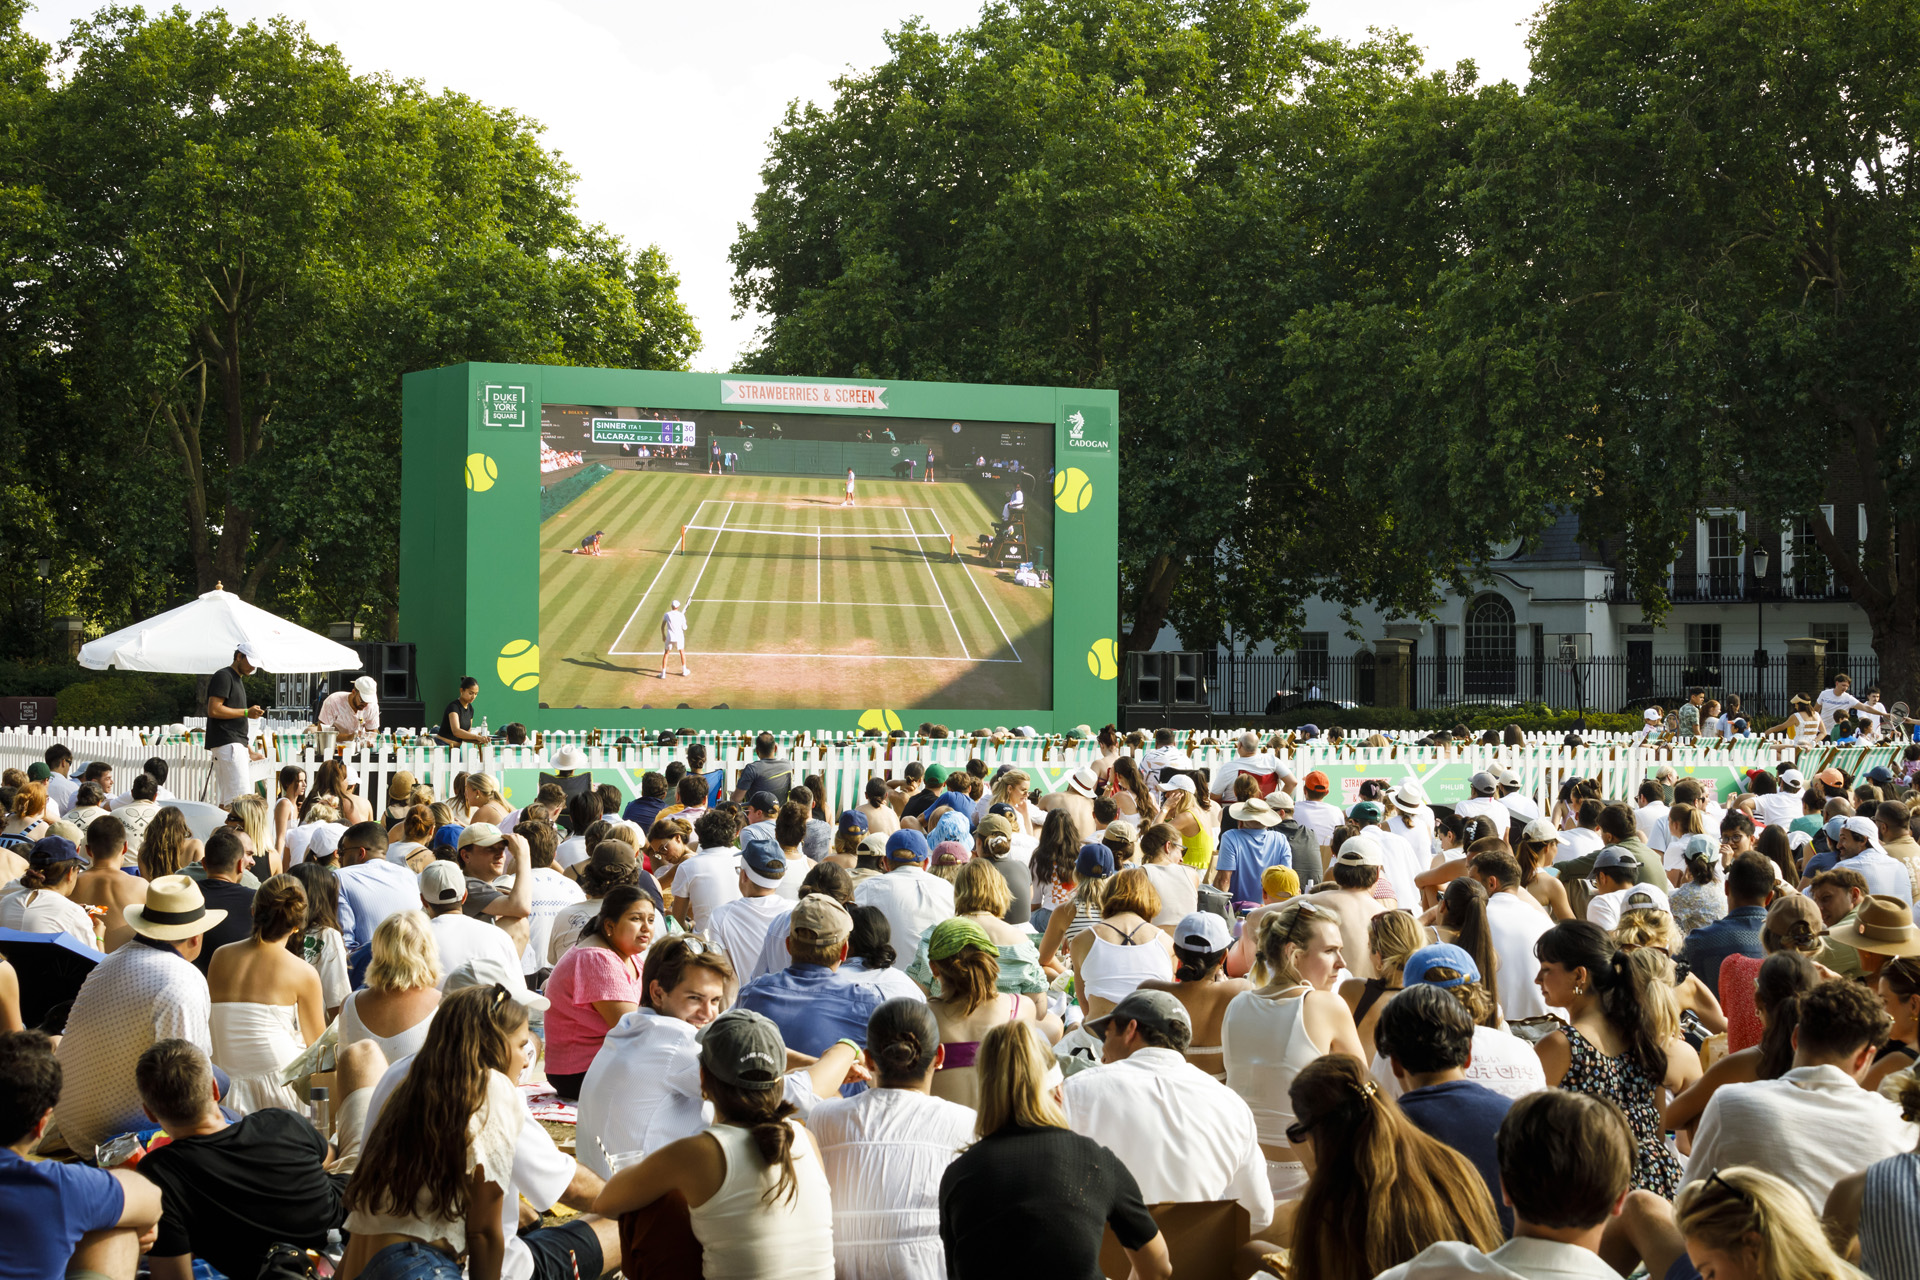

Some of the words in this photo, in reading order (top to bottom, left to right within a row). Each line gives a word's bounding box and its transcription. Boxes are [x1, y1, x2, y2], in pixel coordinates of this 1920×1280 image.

[493, 393, 517, 401] DUKE
[738, 384, 819, 402] STRAWBERRIES
[823, 388, 831, 402] &
[835, 388, 875, 404] SCREEN
[493, 403, 517, 411] YORK
[596, 422, 627, 430] SINNER
[596, 432, 635, 441] ALCARAZ
[1069, 439, 1108, 448] CADOGAN
